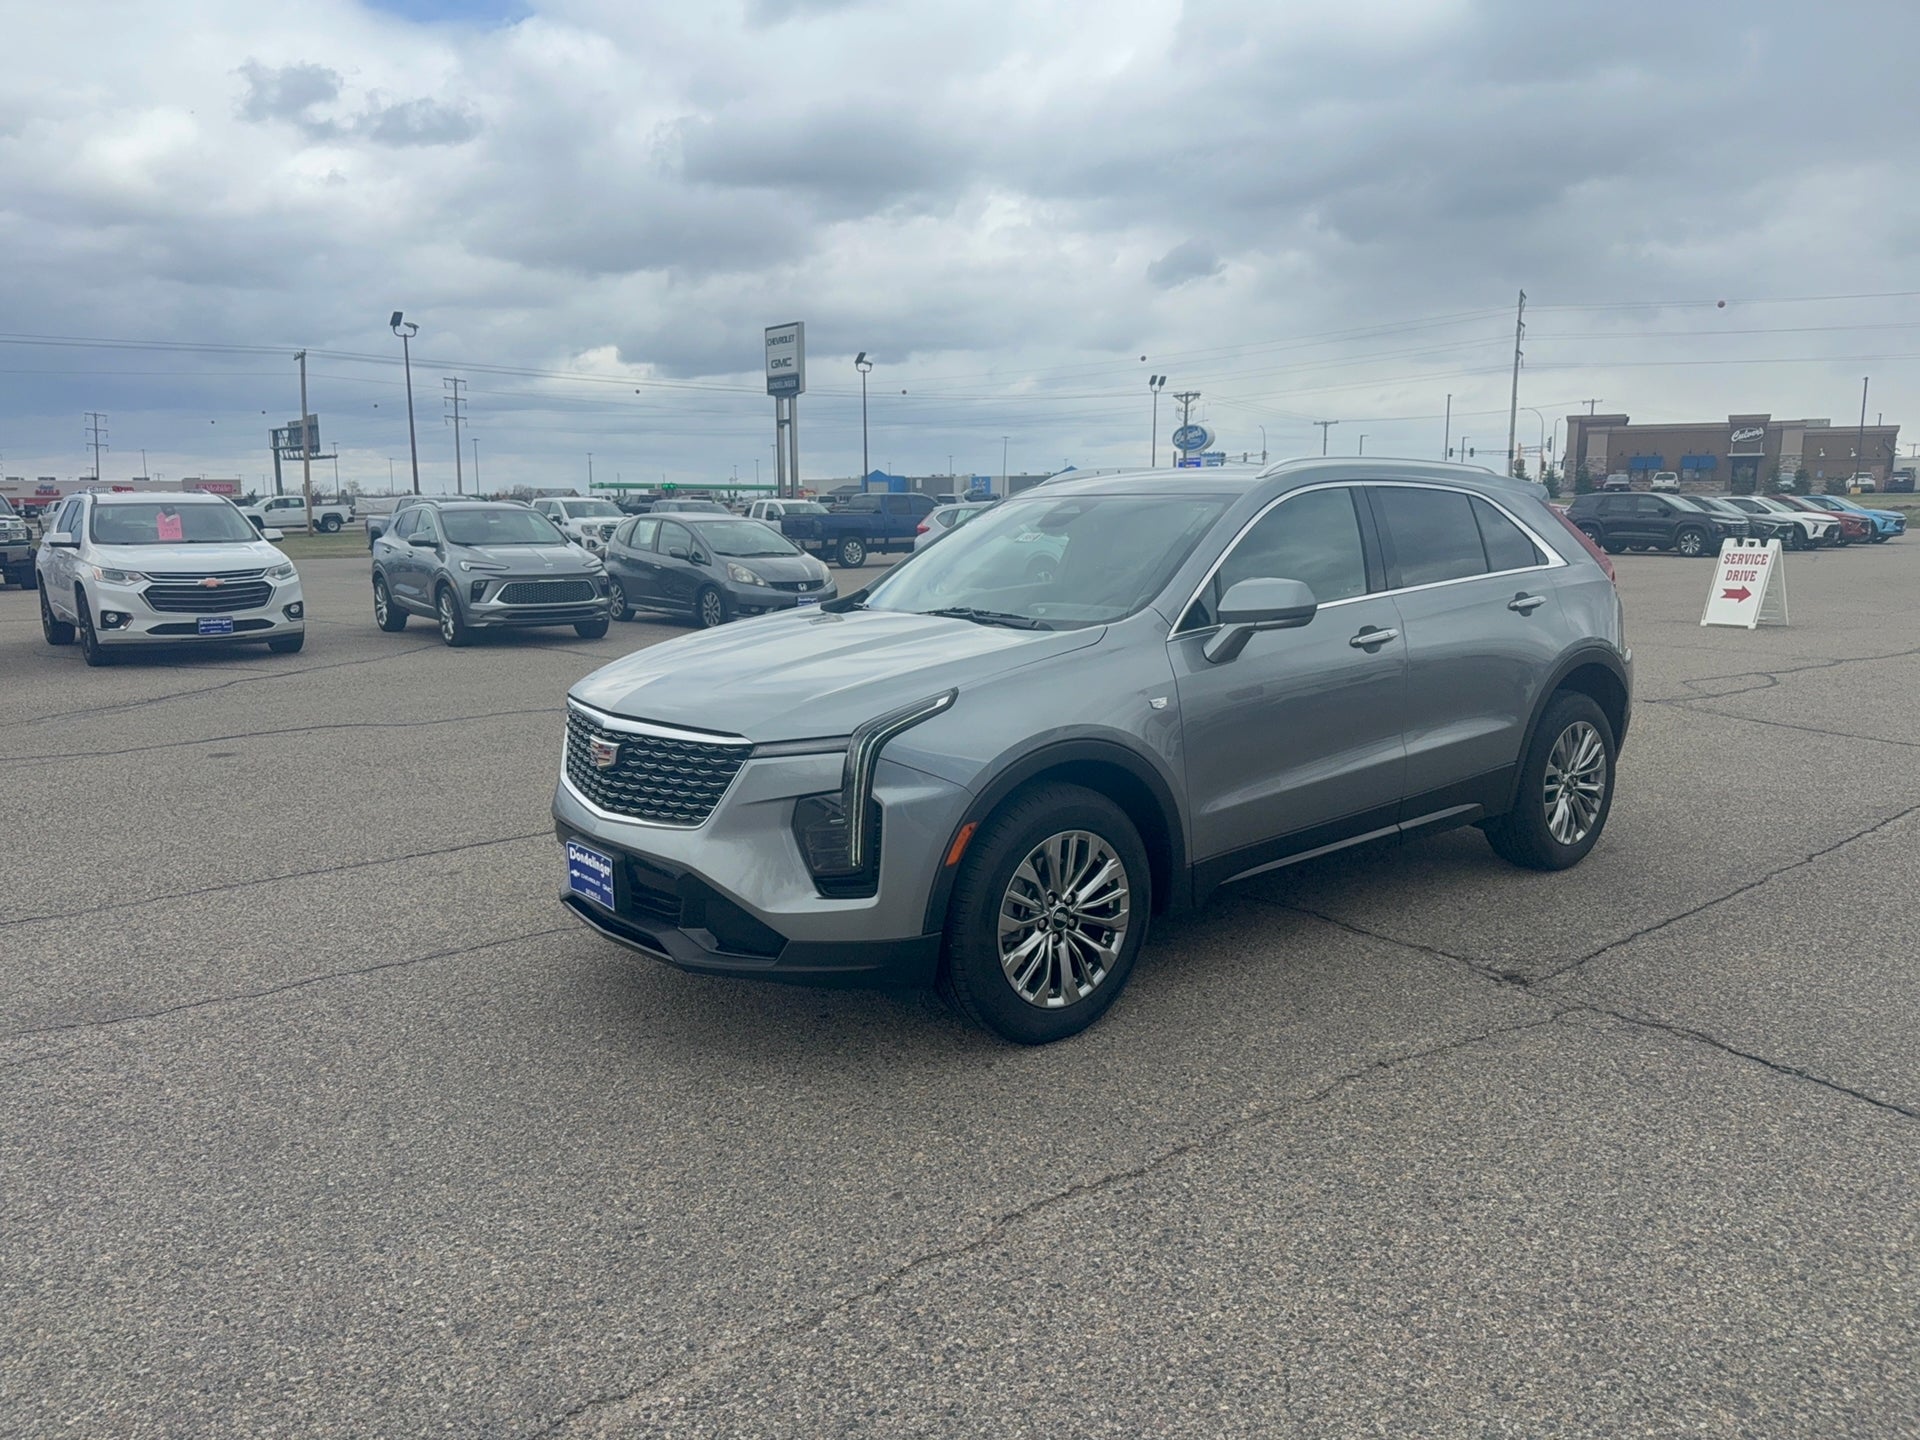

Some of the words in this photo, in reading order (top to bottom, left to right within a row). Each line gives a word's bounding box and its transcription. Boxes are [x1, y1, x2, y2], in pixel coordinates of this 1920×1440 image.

[770, 357, 793, 369] GMC
[1723, 553, 1769, 566] SERVICE
[1725, 570, 1758, 582] DRIVE
[569, 846, 611, 879] Dondelinger
